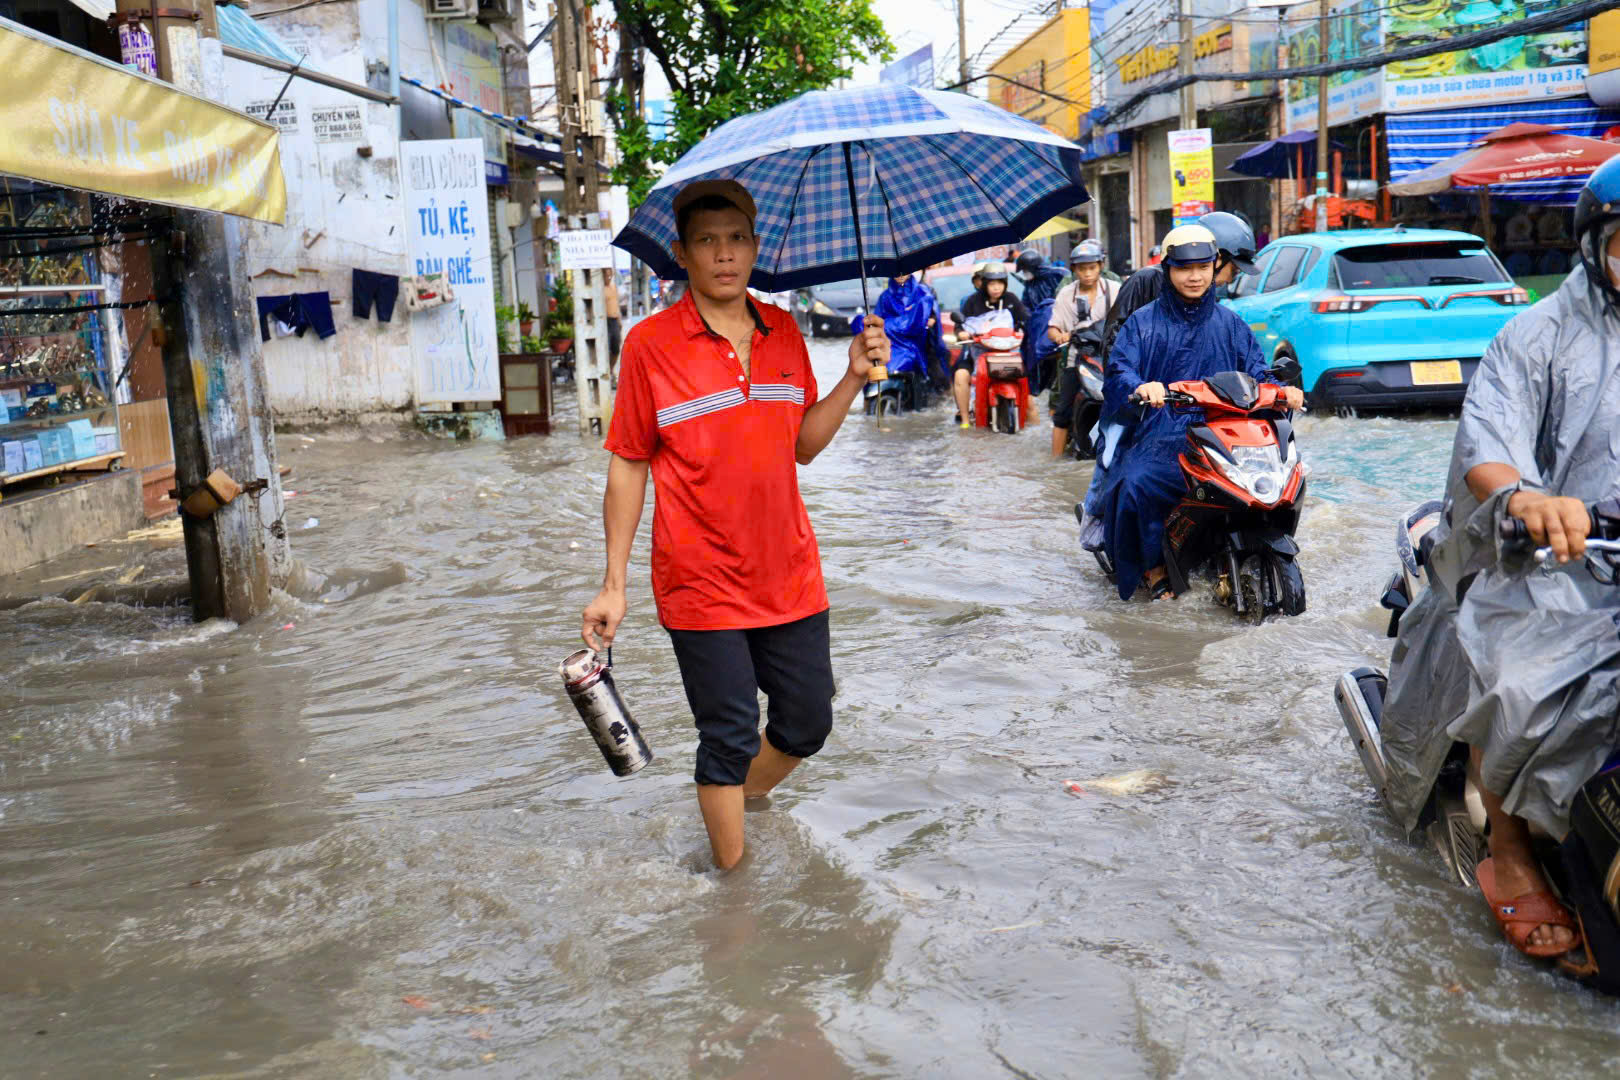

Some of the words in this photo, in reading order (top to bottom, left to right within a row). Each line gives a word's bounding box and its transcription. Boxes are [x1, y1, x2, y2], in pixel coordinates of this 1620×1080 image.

[1396, 83, 1418, 96] Mua
[1494, 74, 1525, 88] motor
[1566, 69, 1573, 80] 3
[418, 198, 445, 239] TỦ,
[448, 200, 475, 241] KỆ,
